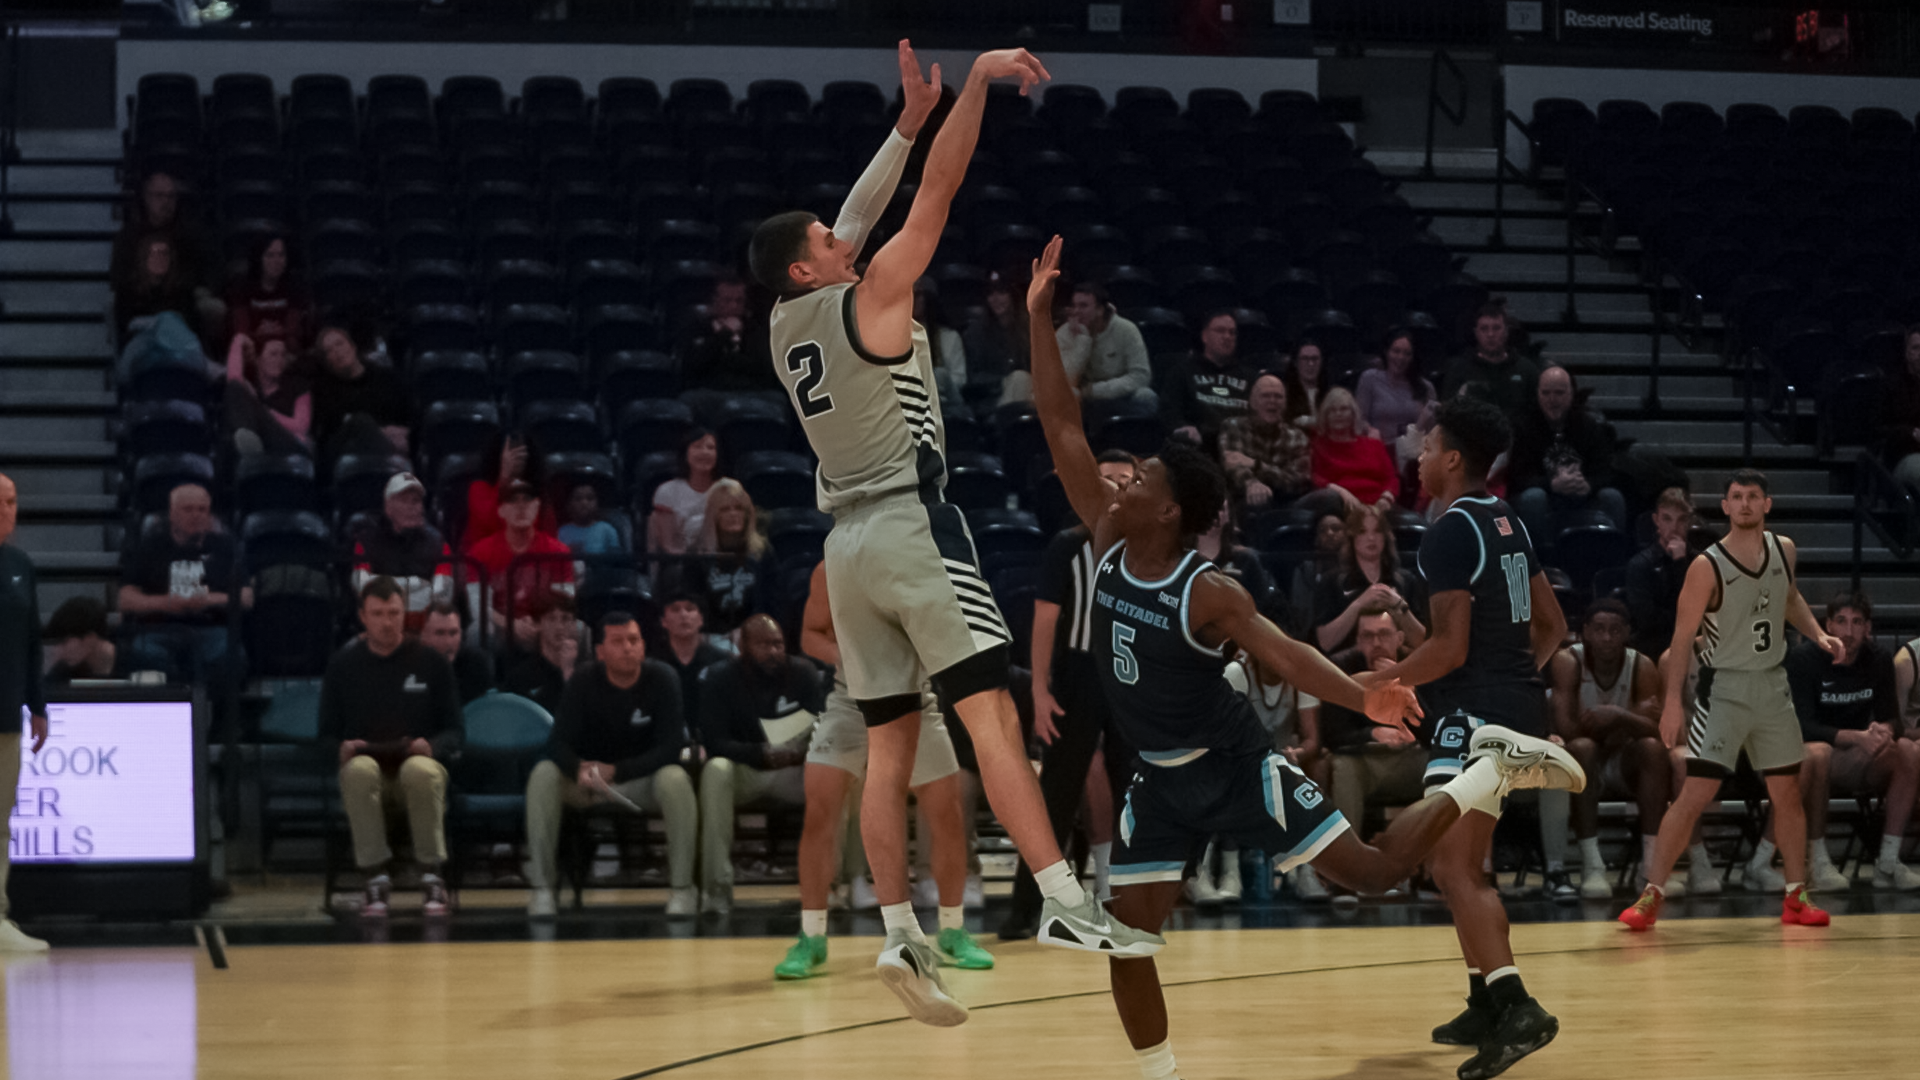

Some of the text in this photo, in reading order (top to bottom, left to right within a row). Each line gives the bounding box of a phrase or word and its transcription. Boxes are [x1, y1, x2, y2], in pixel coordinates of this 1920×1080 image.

[1564, 9, 1713, 36] Reserved Seating
[785, 340, 835, 420] 2
[1096, 589, 1170, 631] THE CITADEL
[1500, 552, 1531, 623] 10
[1112, 620, 1139, 685] 5
[1752, 619, 1771, 654] 3
